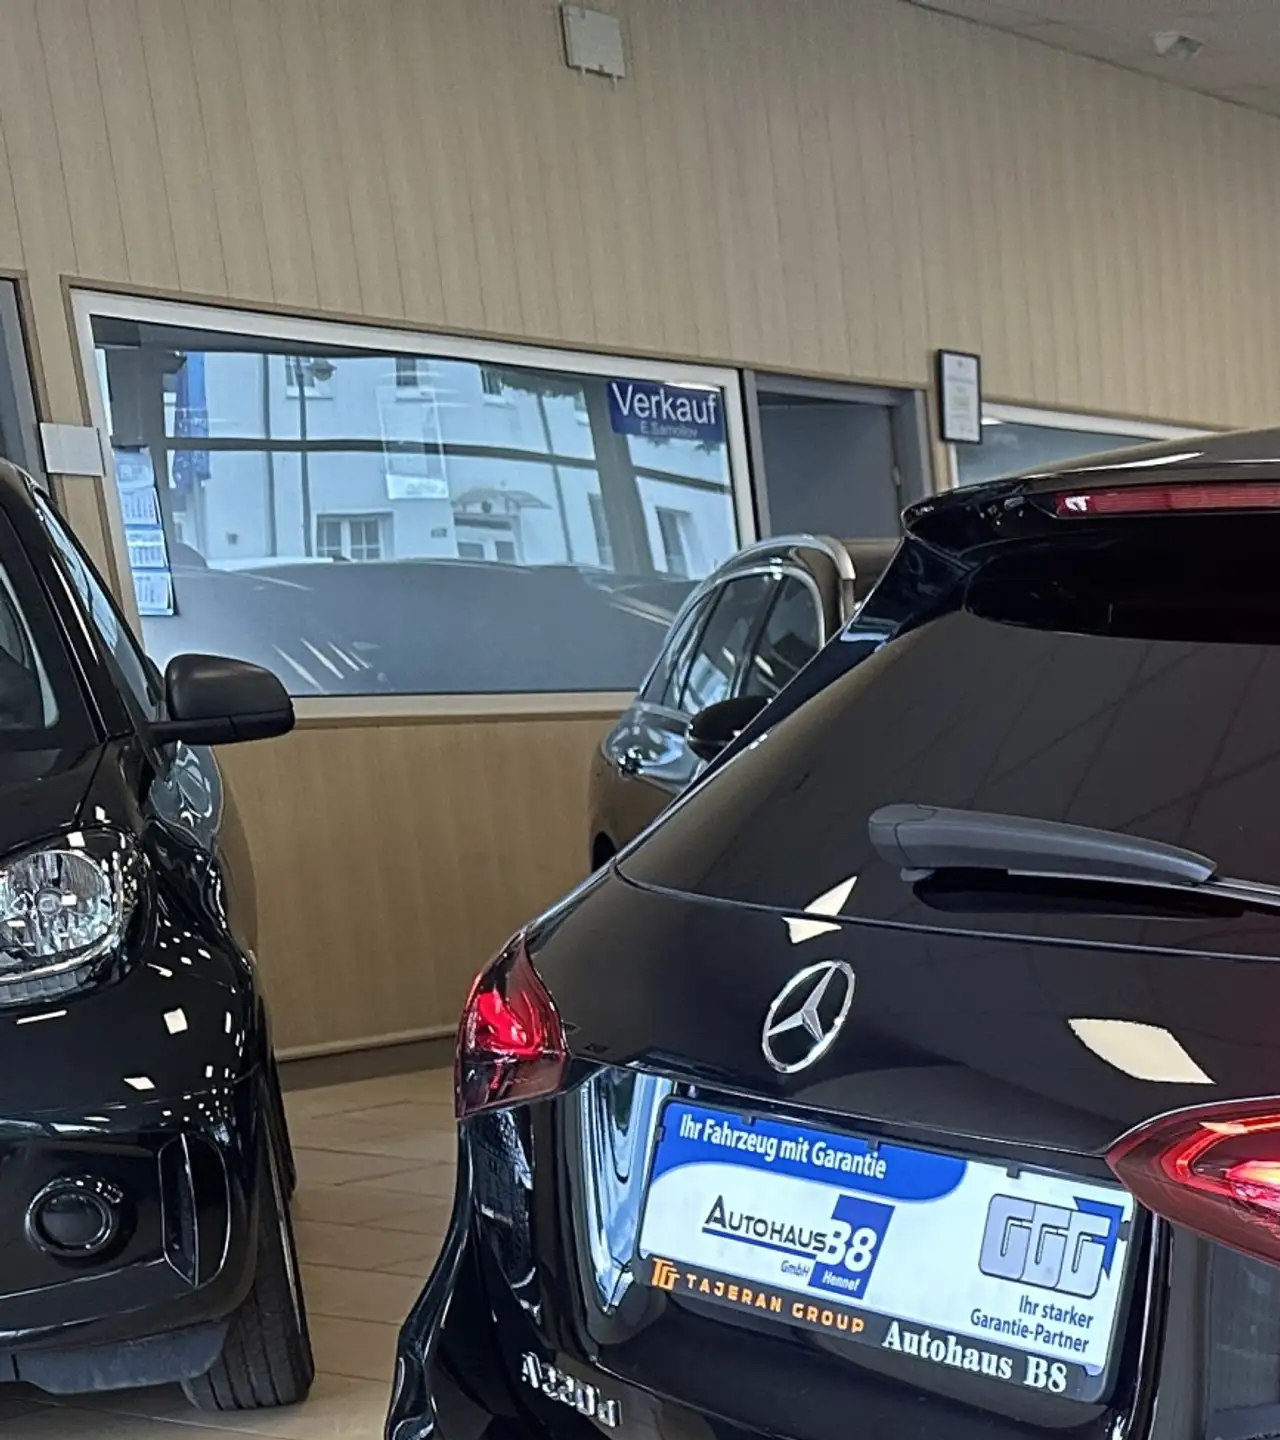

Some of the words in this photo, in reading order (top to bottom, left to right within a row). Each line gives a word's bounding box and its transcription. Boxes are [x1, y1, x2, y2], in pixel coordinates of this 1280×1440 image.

[612, 382, 716, 425] Verkauf
[679, 1114, 701, 1139] Ihr
[703, 1119, 778, 1162] Fahrzeug
[780, 1137, 809, 1163] mit
[812, 1142, 887, 1179] Garantie
[815, 1218, 878, 1272] B8
[781, 1260, 810, 1278] GmbH
[822, 1270, 861, 1291] Hennef
[686, 1273, 782, 1313] TAJERAN
[792, 1302, 865, 1334] GROUP
[1019, 1295, 1037, 1316] Ihr
[1041, 1304, 1094, 1329] starker
[970, 1308, 1090, 1353] Garantie-Partner
[882, 1321, 1013, 1380] Autohaus
[1023, 1355, 1068, 1393] B8
